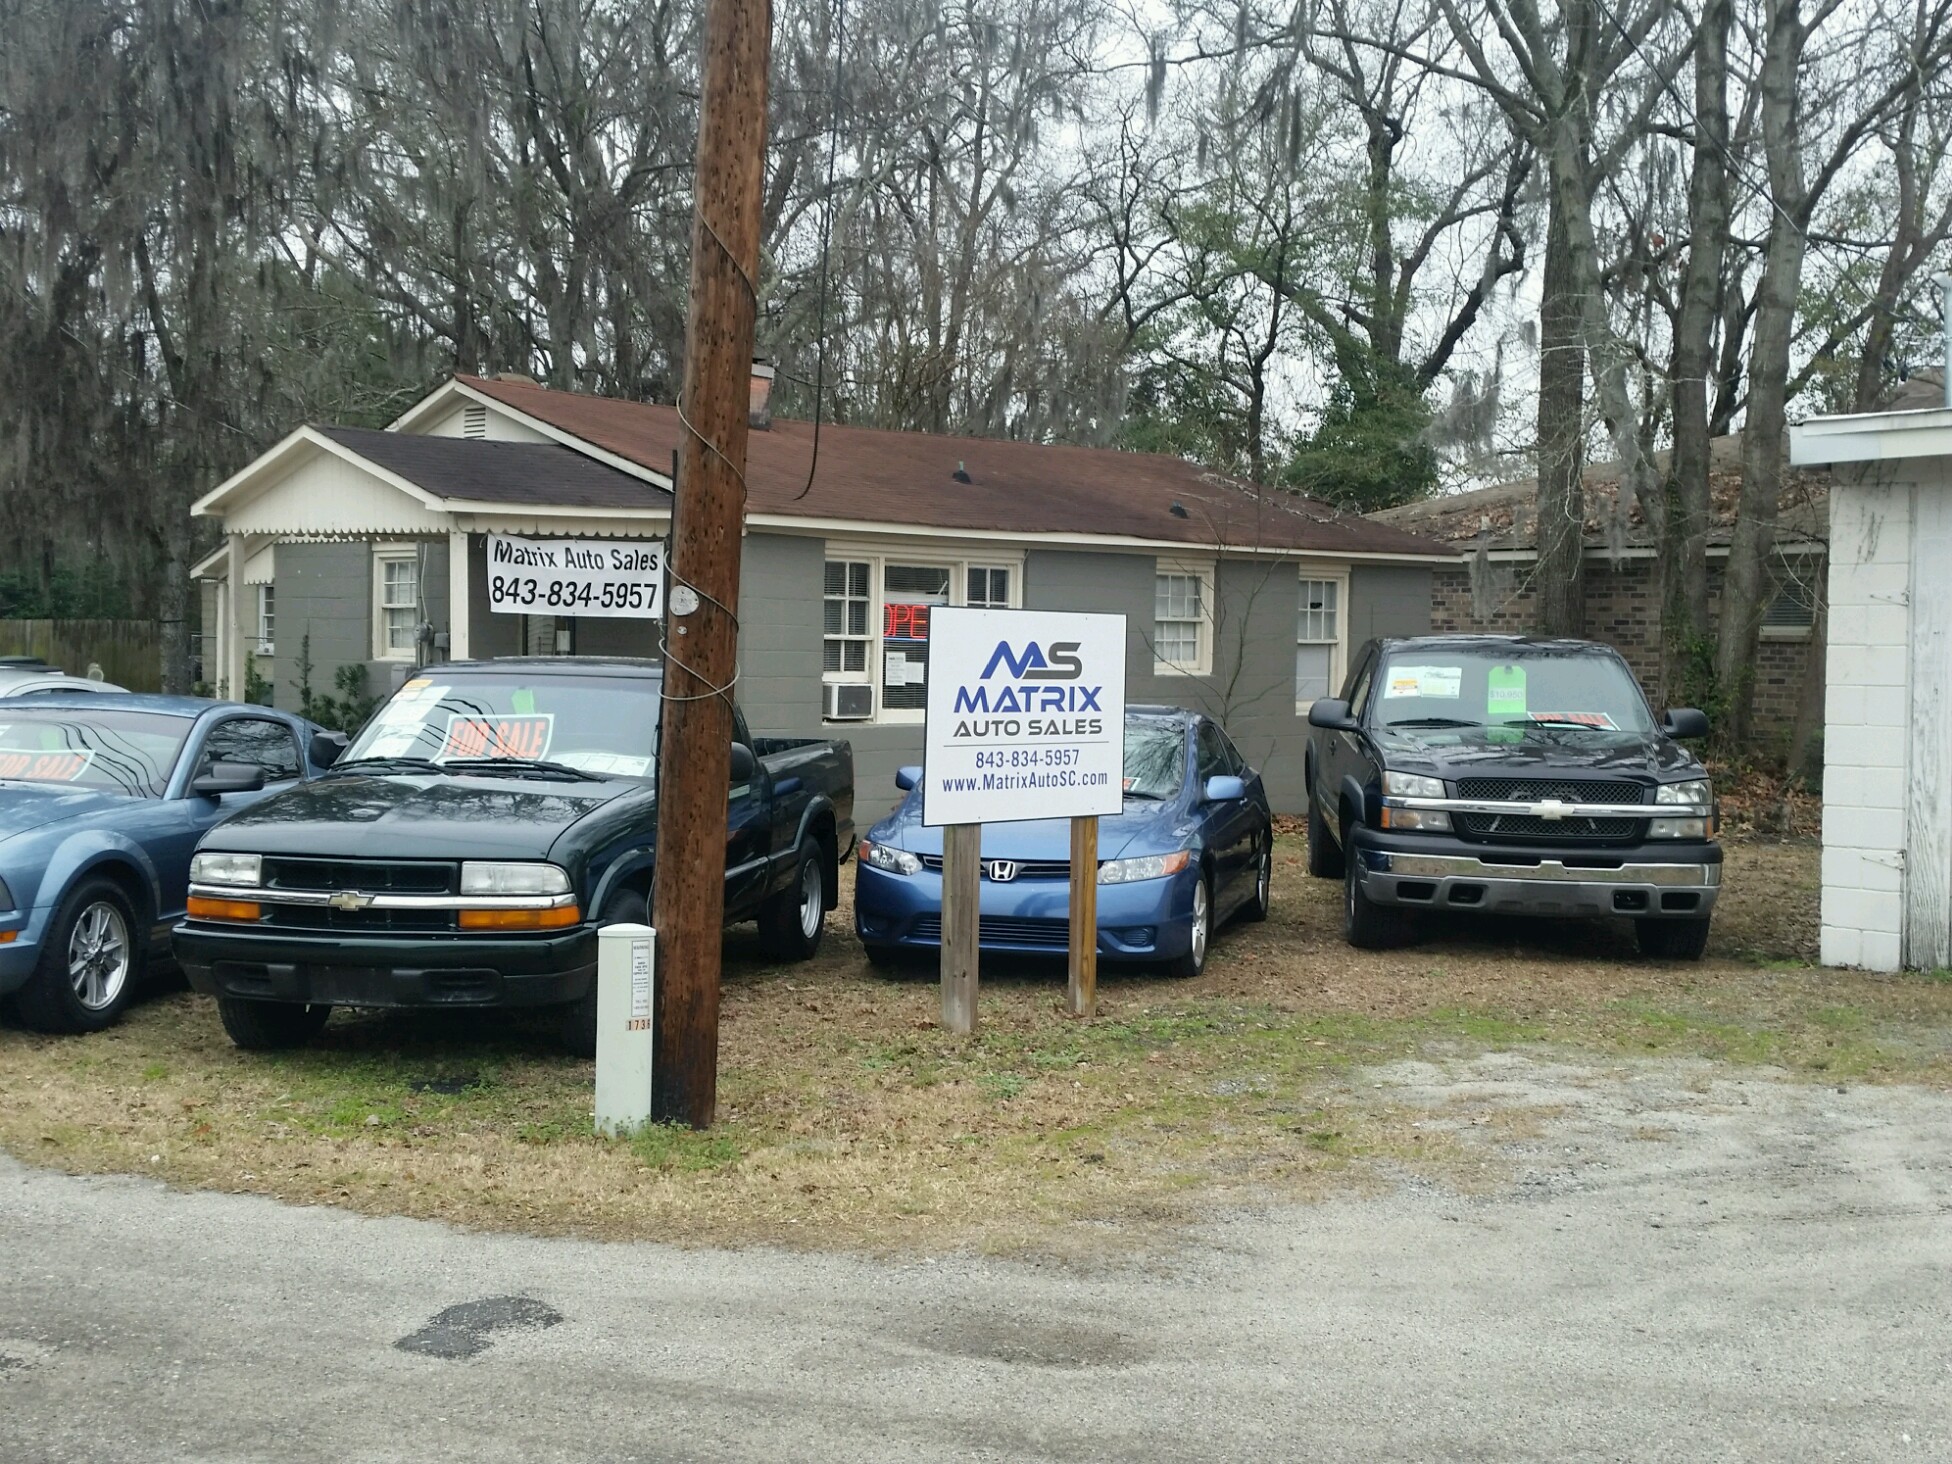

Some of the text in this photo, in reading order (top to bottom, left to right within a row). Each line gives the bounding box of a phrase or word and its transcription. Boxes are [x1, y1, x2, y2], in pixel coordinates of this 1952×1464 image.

[494, 540, 659, 571] Matrix Auto Sales
[492, 575, 658, 609] 843-834-5957
[884, 604, 928, 638] OPE
[953, 685, 1103, 714] MATRIX
[443, 720, 546, 758] FOR SALE
[953, 718, 1103, 738] AUTO SALES
[0, 753, 31, 778] OR
[975, 749, 1080, 769] 843-834-5957
[942, 770, 1108, 793] www.MatrixAutoSC.com
